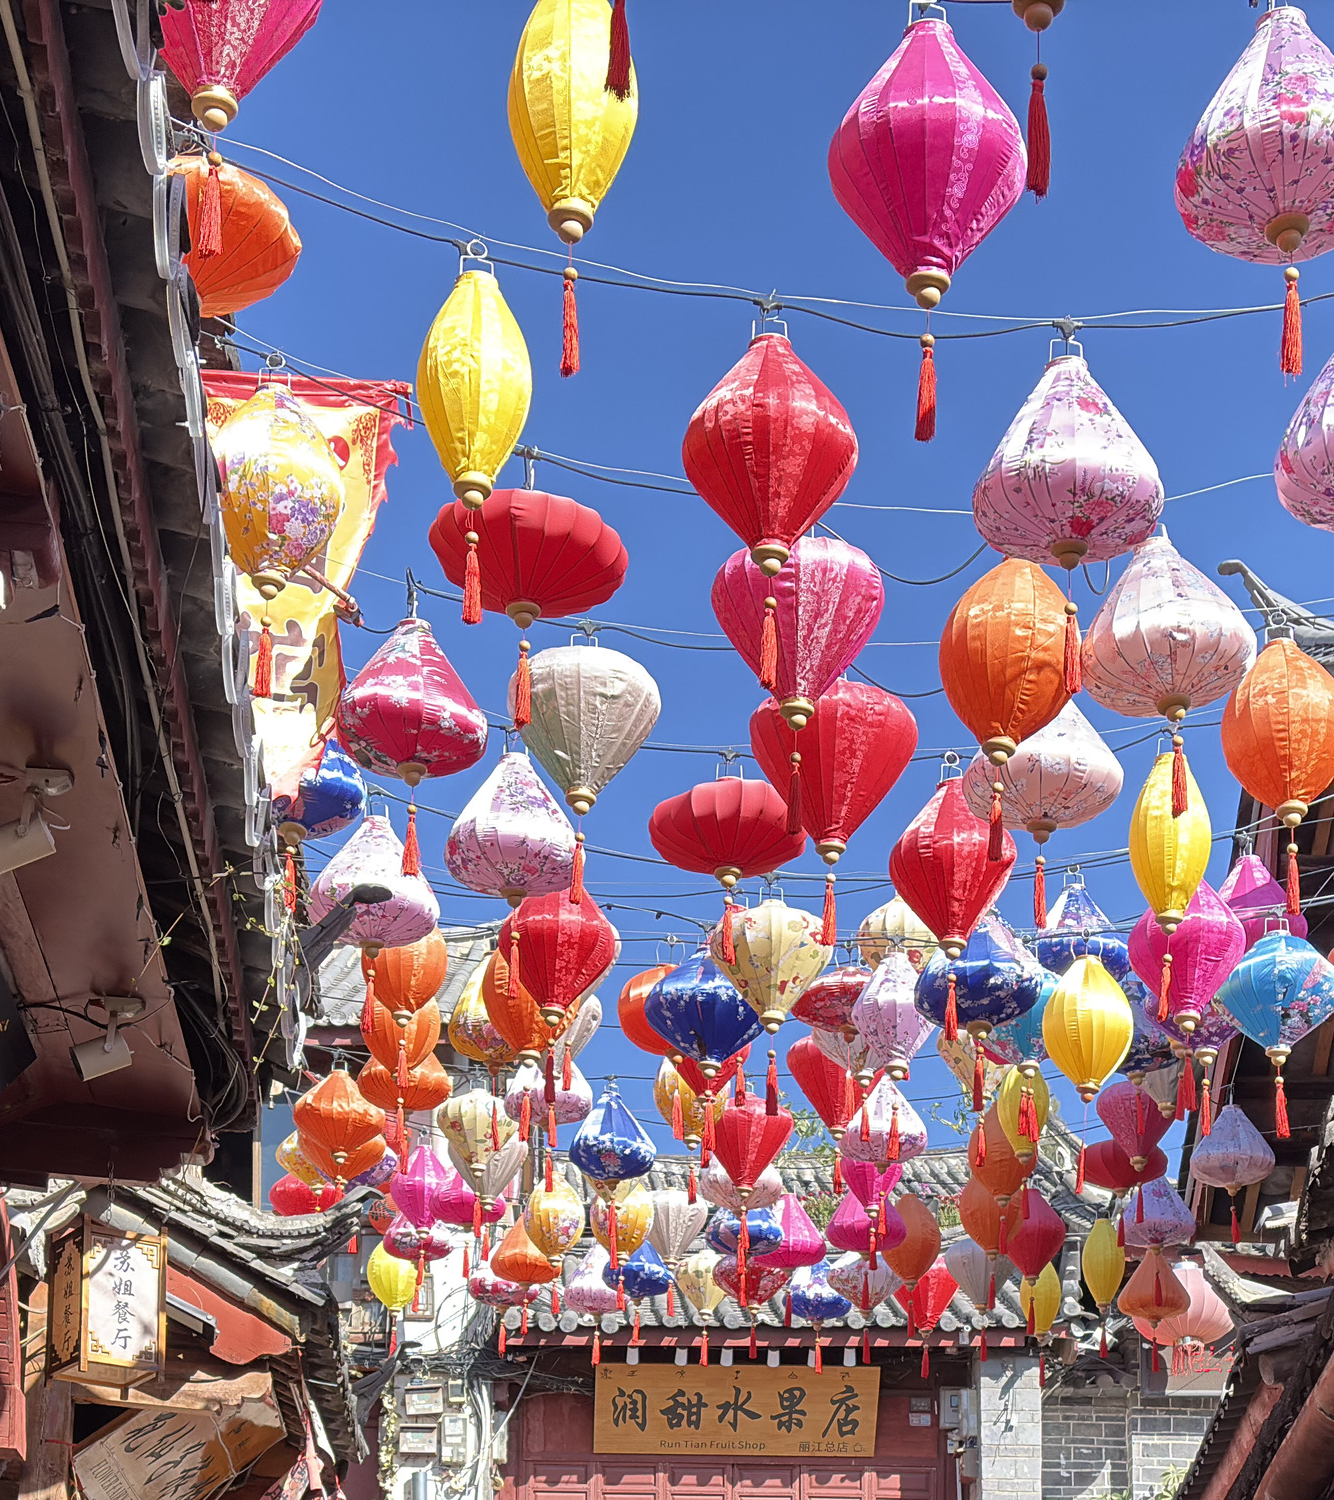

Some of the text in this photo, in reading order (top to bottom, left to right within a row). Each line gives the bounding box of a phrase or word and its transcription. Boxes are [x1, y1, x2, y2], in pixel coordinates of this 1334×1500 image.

[111, 1249, 135, 1350] 苏姐餐厅
[612, 1385, 861, 1439] 润甜水果店
[660, 1440, 766, 1451] Run Tian Fruit Shop
[798, 1441, 849, 1452] 丽江总店
